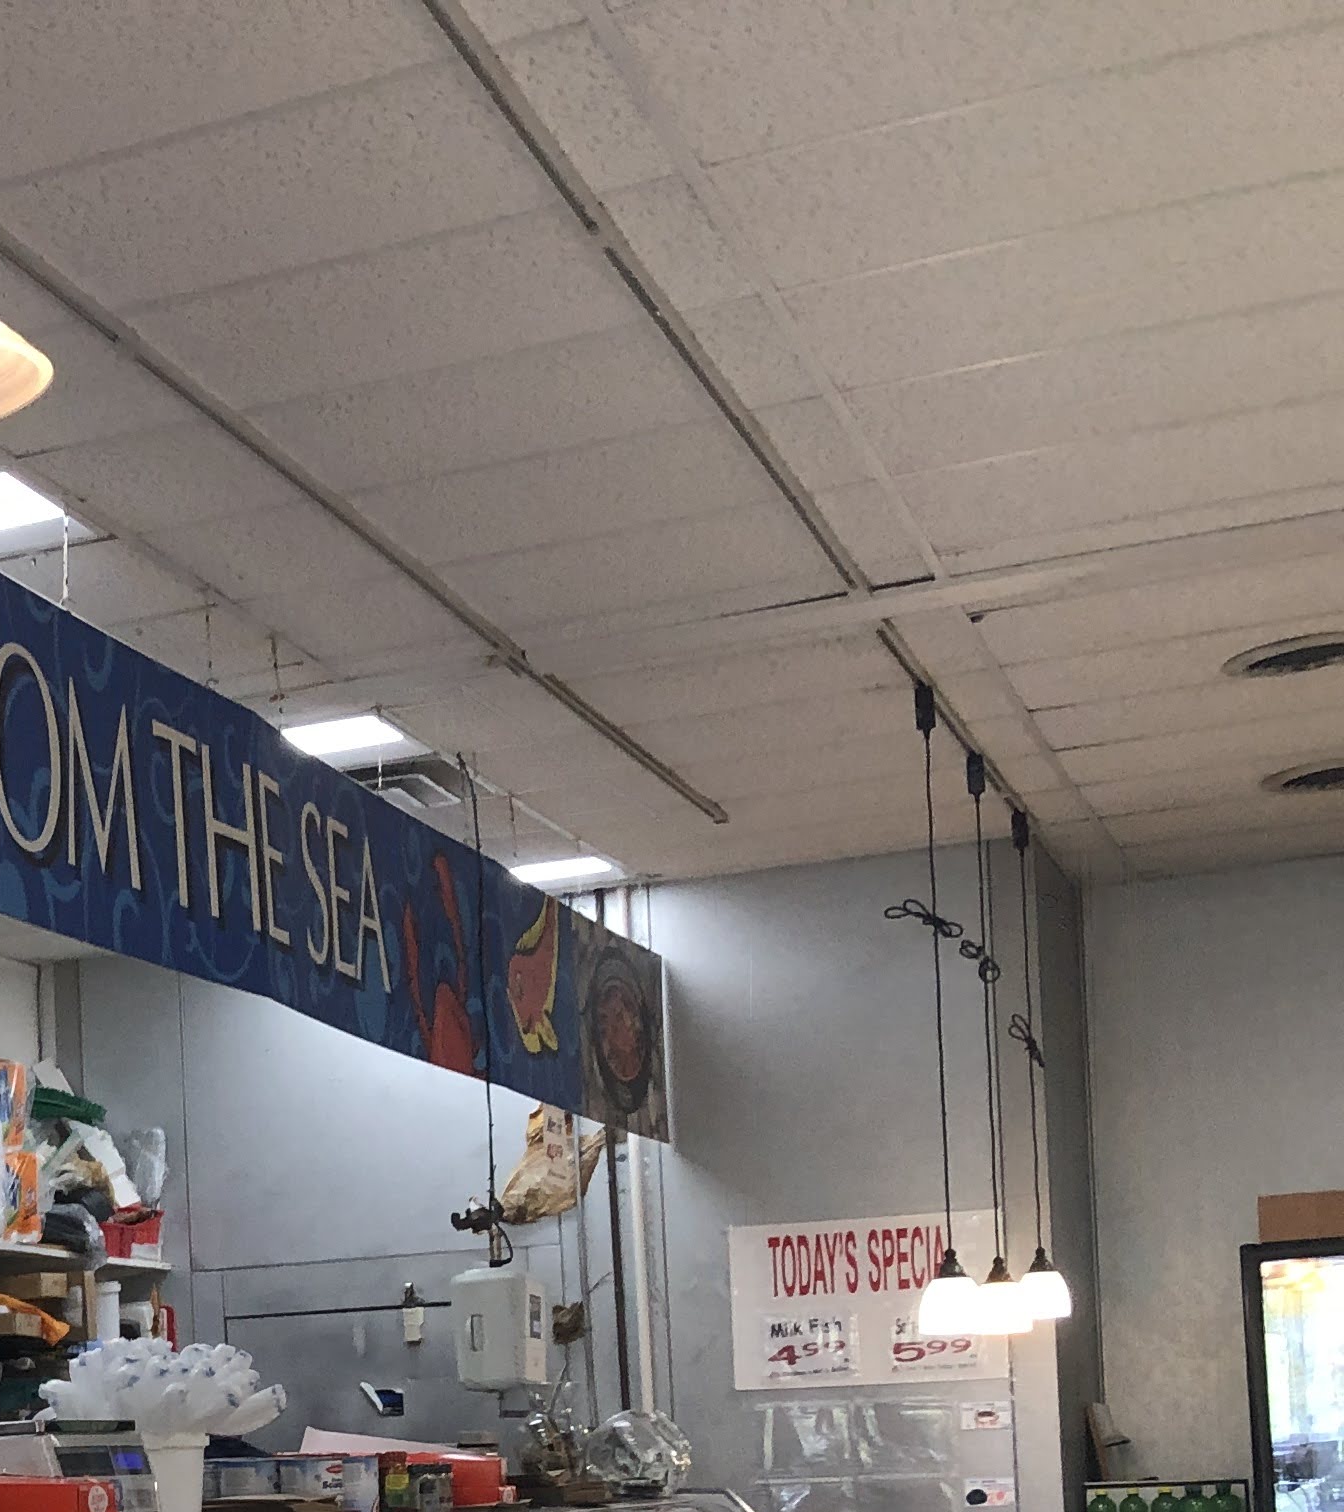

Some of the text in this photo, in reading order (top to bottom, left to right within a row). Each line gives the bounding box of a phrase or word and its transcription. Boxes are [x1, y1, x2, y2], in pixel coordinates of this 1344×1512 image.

[152, 718, 291, 947] THE
[299, 801, 393, 994] SEA
[767, 1225, 946, 1297] TODAY'S SPECIA
